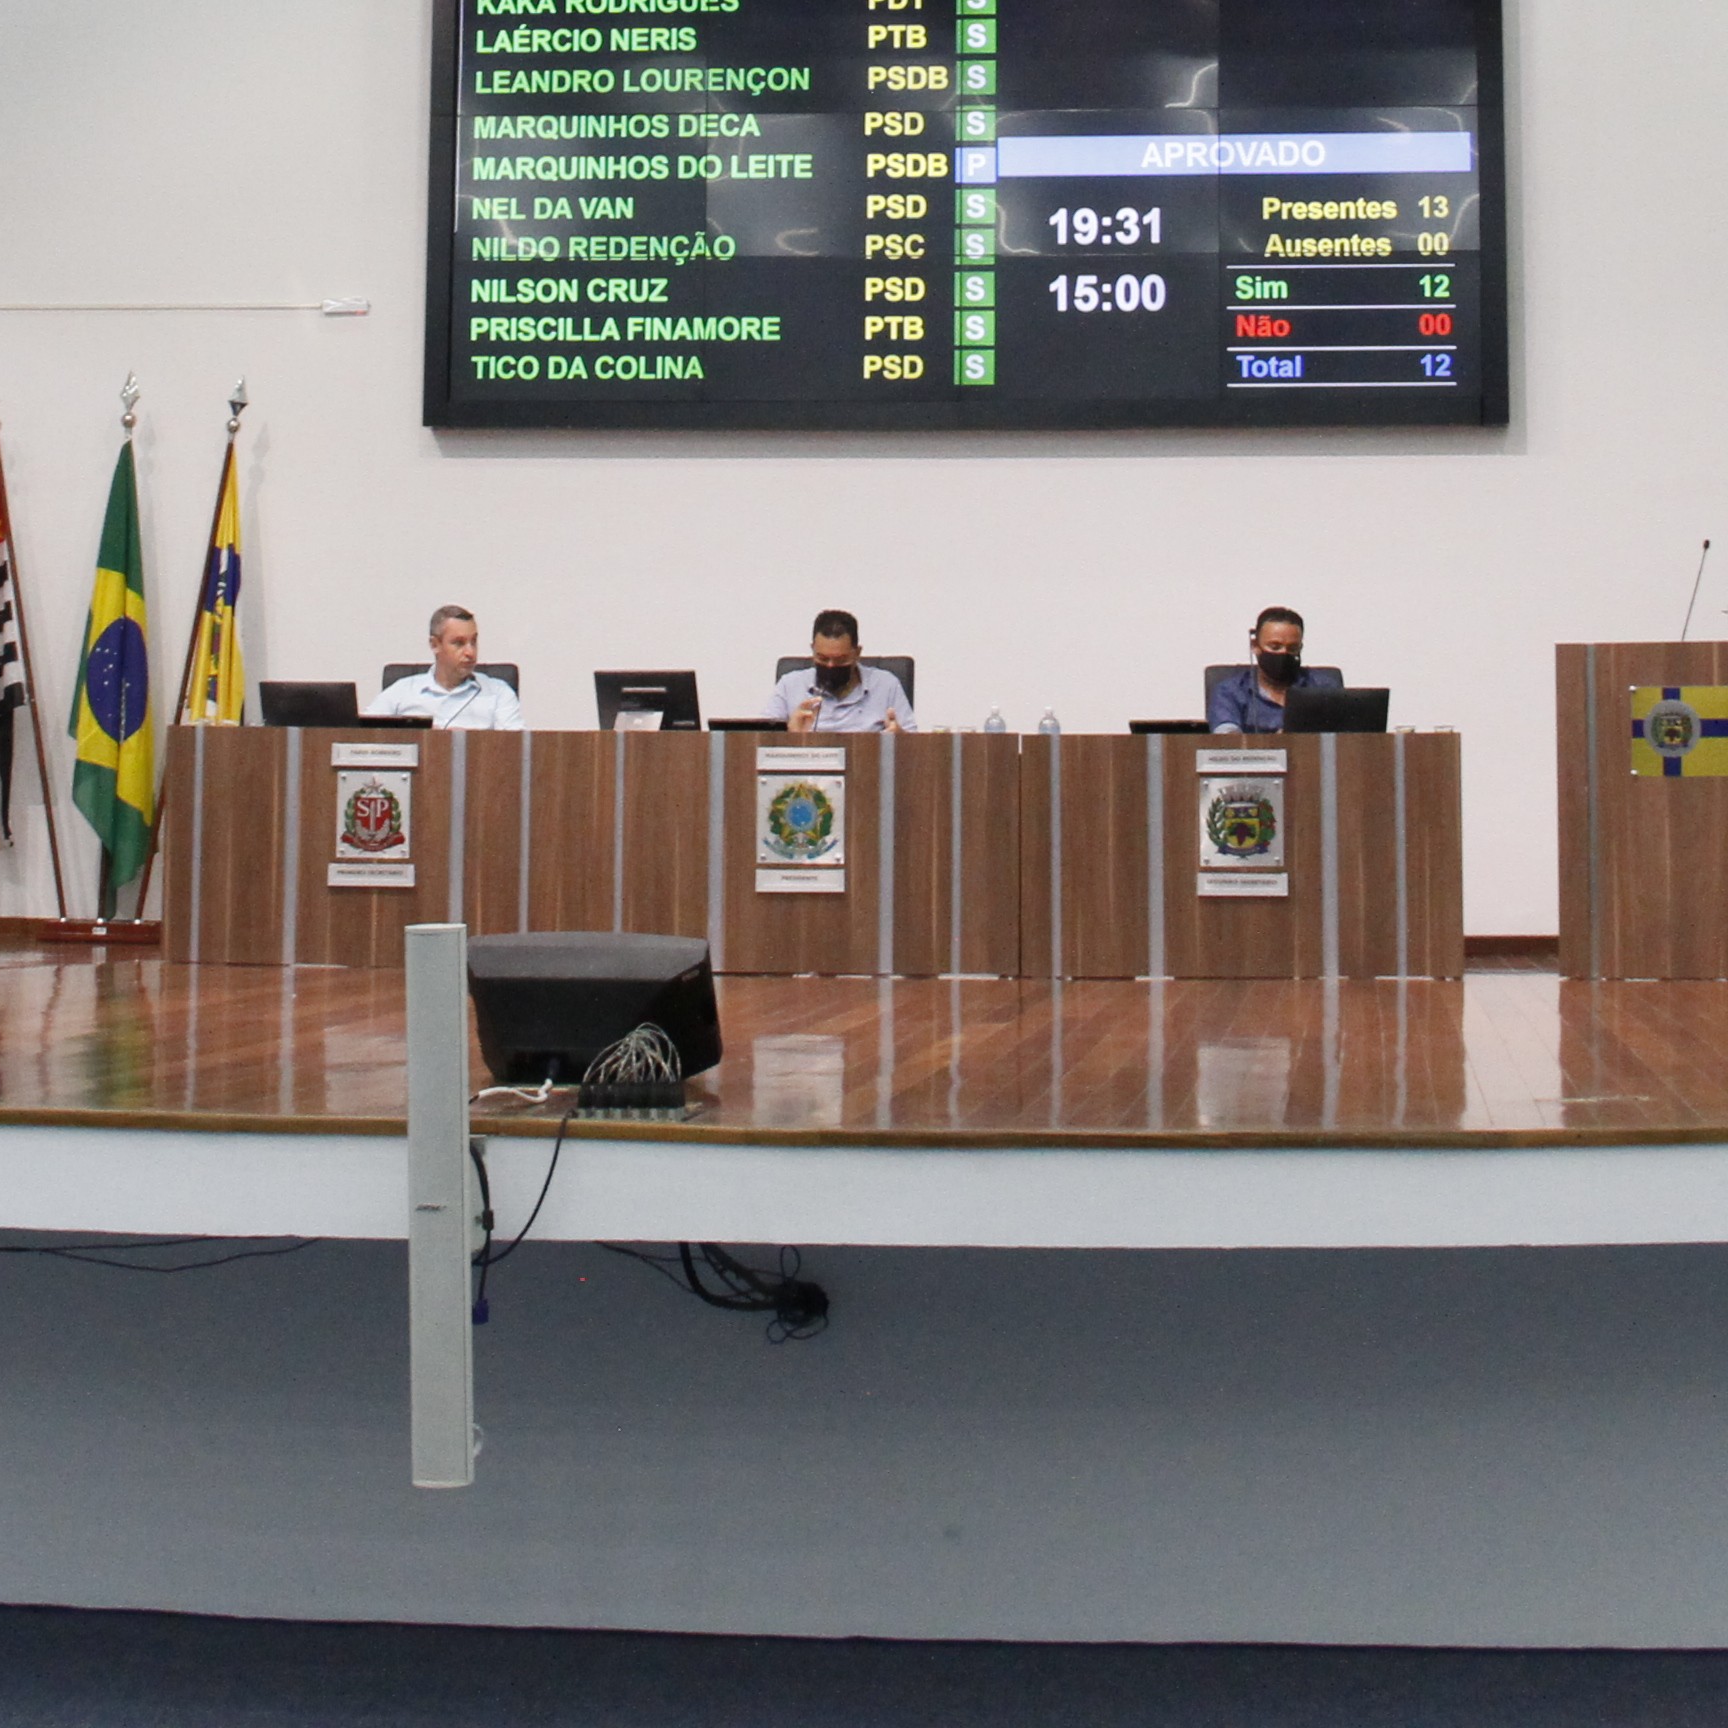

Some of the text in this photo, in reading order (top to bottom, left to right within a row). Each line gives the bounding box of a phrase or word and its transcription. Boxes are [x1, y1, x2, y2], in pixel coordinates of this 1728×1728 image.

[476, 25, 985, 53] LAÉRCIO NERIS PTB S
[475, 66, 986, 96] LEANDRO LOURENÇON PSDB S
[473, 112, 985, 140] MARQUINHOS DECA PSD S
[1142, 140, 1326, 168] APROVADO
[473, 154, 985, 181] MARQUINHOS DO LEITE PSDB P
[472, 195, 985, 220] NEL DA VAN PSD S
[1263, 197, 1449, 221] Presentes 13
[1049, 207, 1162, 245] 19:31
[472, 231, 985, 265] NILDO REDENÇÃO PSC S
[1264, 232, 1449, 257] Ausentes 00
[471, 278, 985, 303] NILSON CRUZ PSD S
[1049, 274, 1166, 312] 15:00
[1235, 275, 1450, 300] Sim 12
[471, 316, 985, 342] PRISCILLA FINAMORE PTB S
[1236, 314, 1451, 338] Não 00
[472, 355, 985, 380] TICO DA COLINA PSD S
[1237, 355, 1451, 378] Total 12
